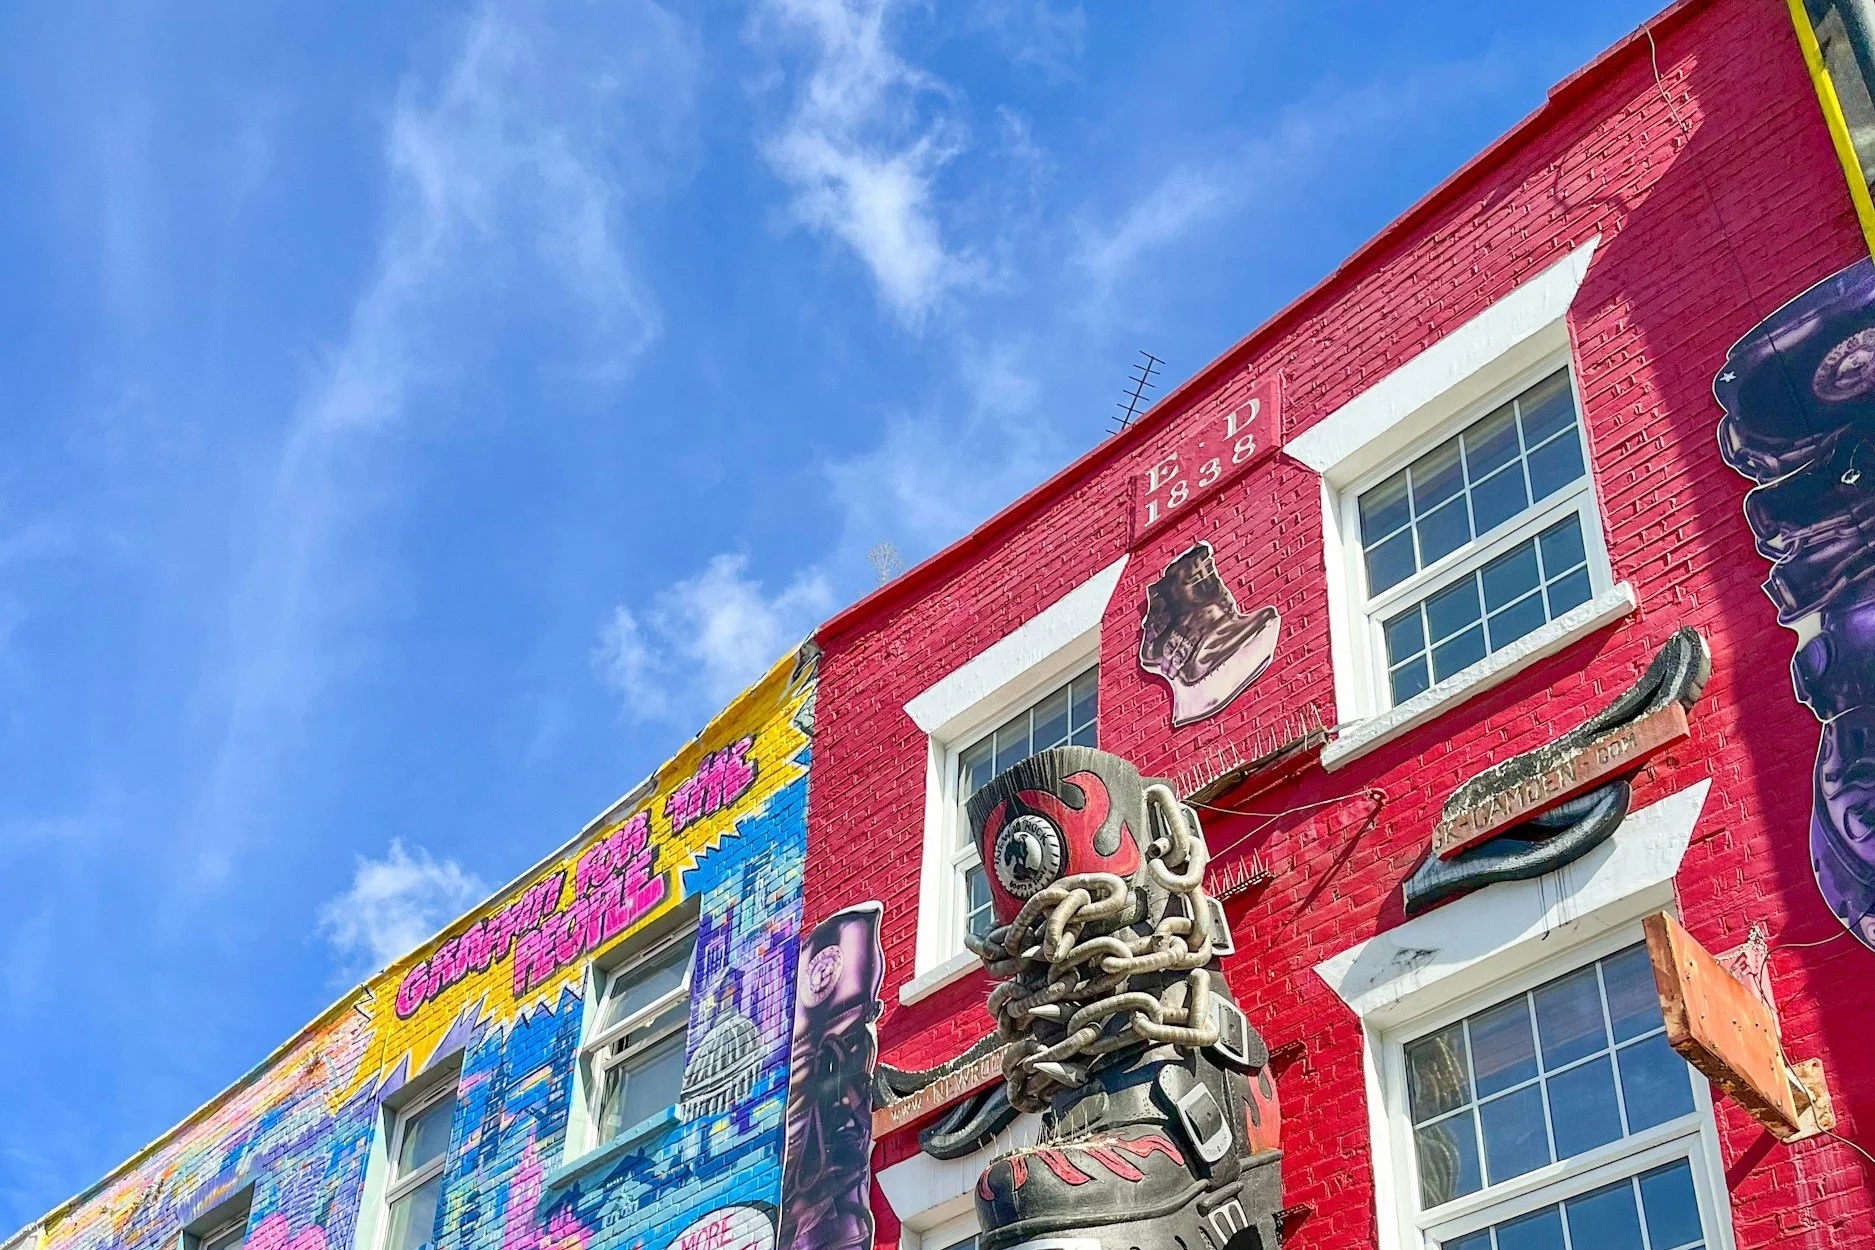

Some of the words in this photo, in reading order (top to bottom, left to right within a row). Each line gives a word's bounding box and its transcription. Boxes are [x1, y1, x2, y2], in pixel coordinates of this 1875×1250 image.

[1144, 434, 1257, 528] 1838
[575, 809, 652, 897] FOR
[664, 735, 758, 834] THE
[513, 846, 670, 1000] PEOPLE
